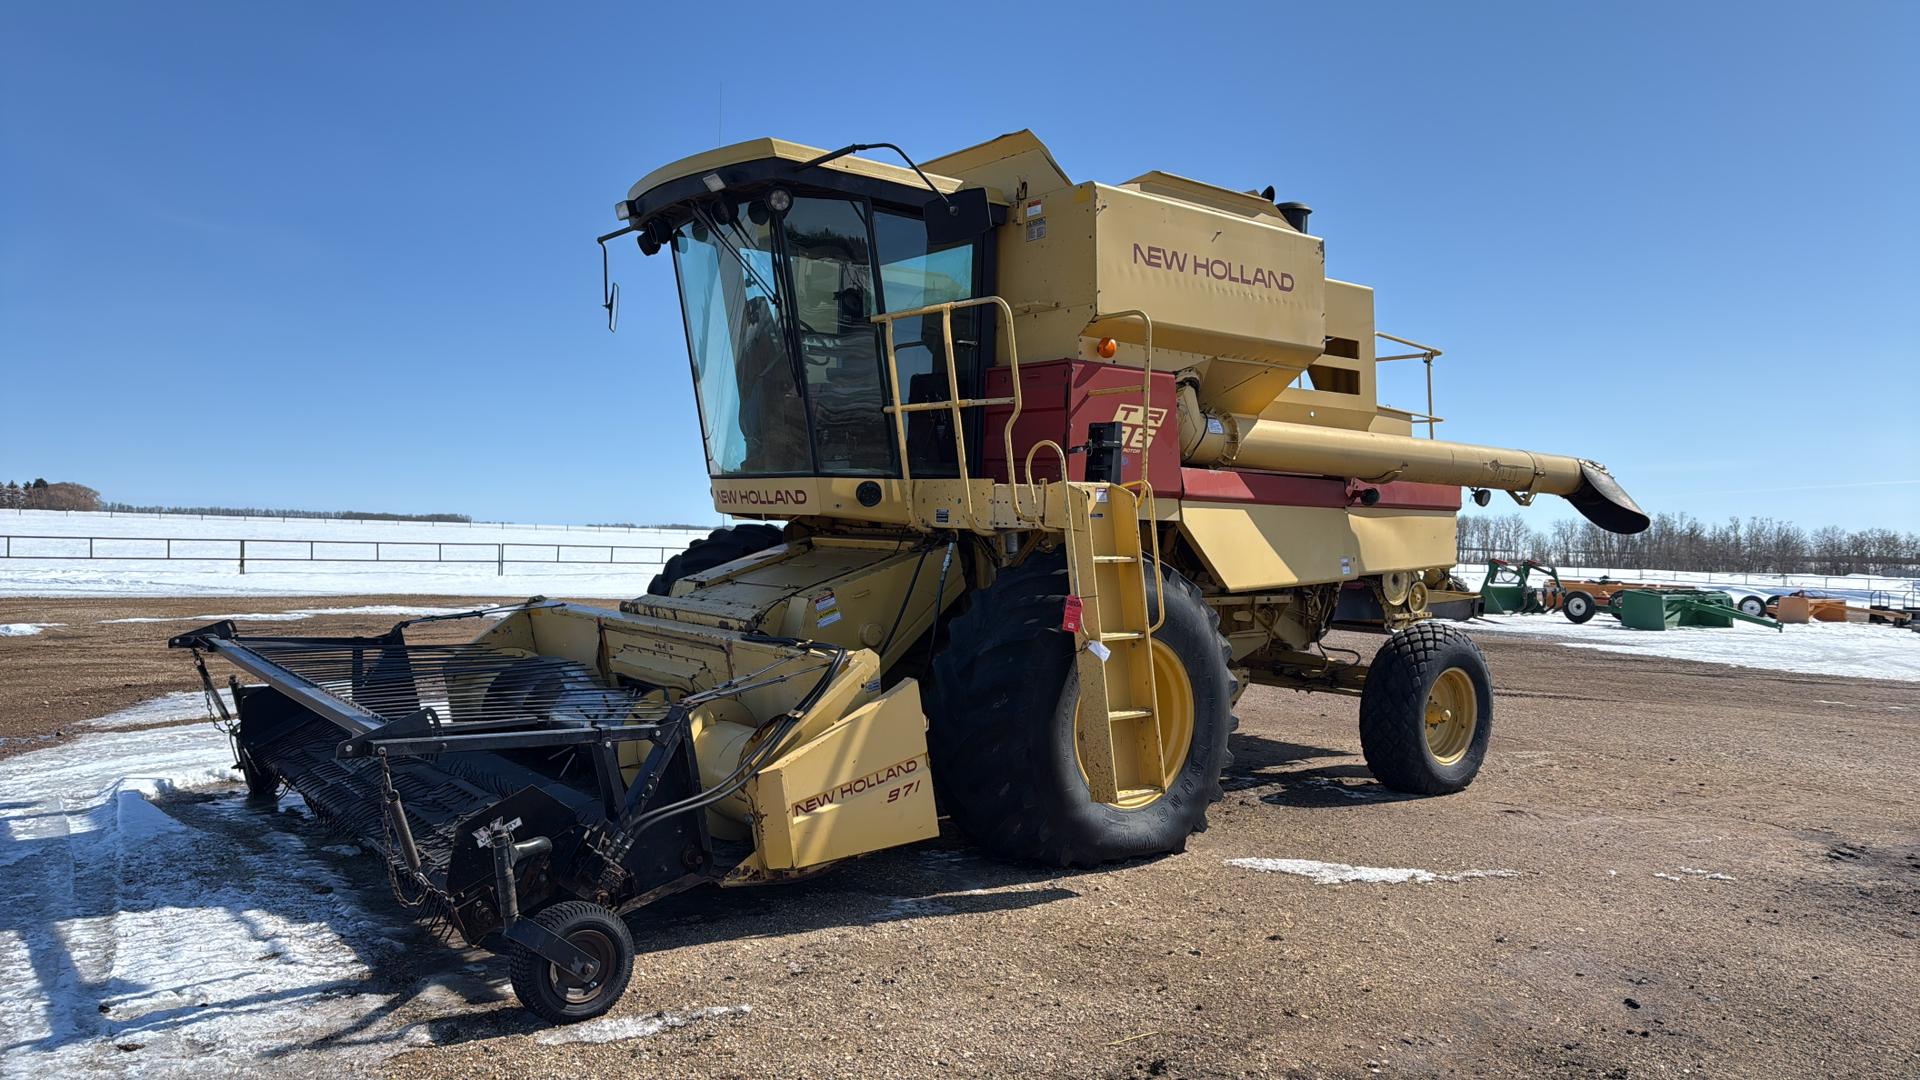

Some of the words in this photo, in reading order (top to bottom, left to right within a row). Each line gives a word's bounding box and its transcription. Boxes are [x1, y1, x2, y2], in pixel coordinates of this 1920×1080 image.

[1133, 243, 1188, 273] NEW
[1193, 254, 1295, 292] HOLLAND
[1119, 406, 1165, 424] TR
[716, 489, 737, 504] NEW
[738, 489, 808, 505] HOLLAND
[794, 790, 836, 817] NEW
[840, 760, 918, 799] HOLLAND
[886, 780, 921, 804] 971
